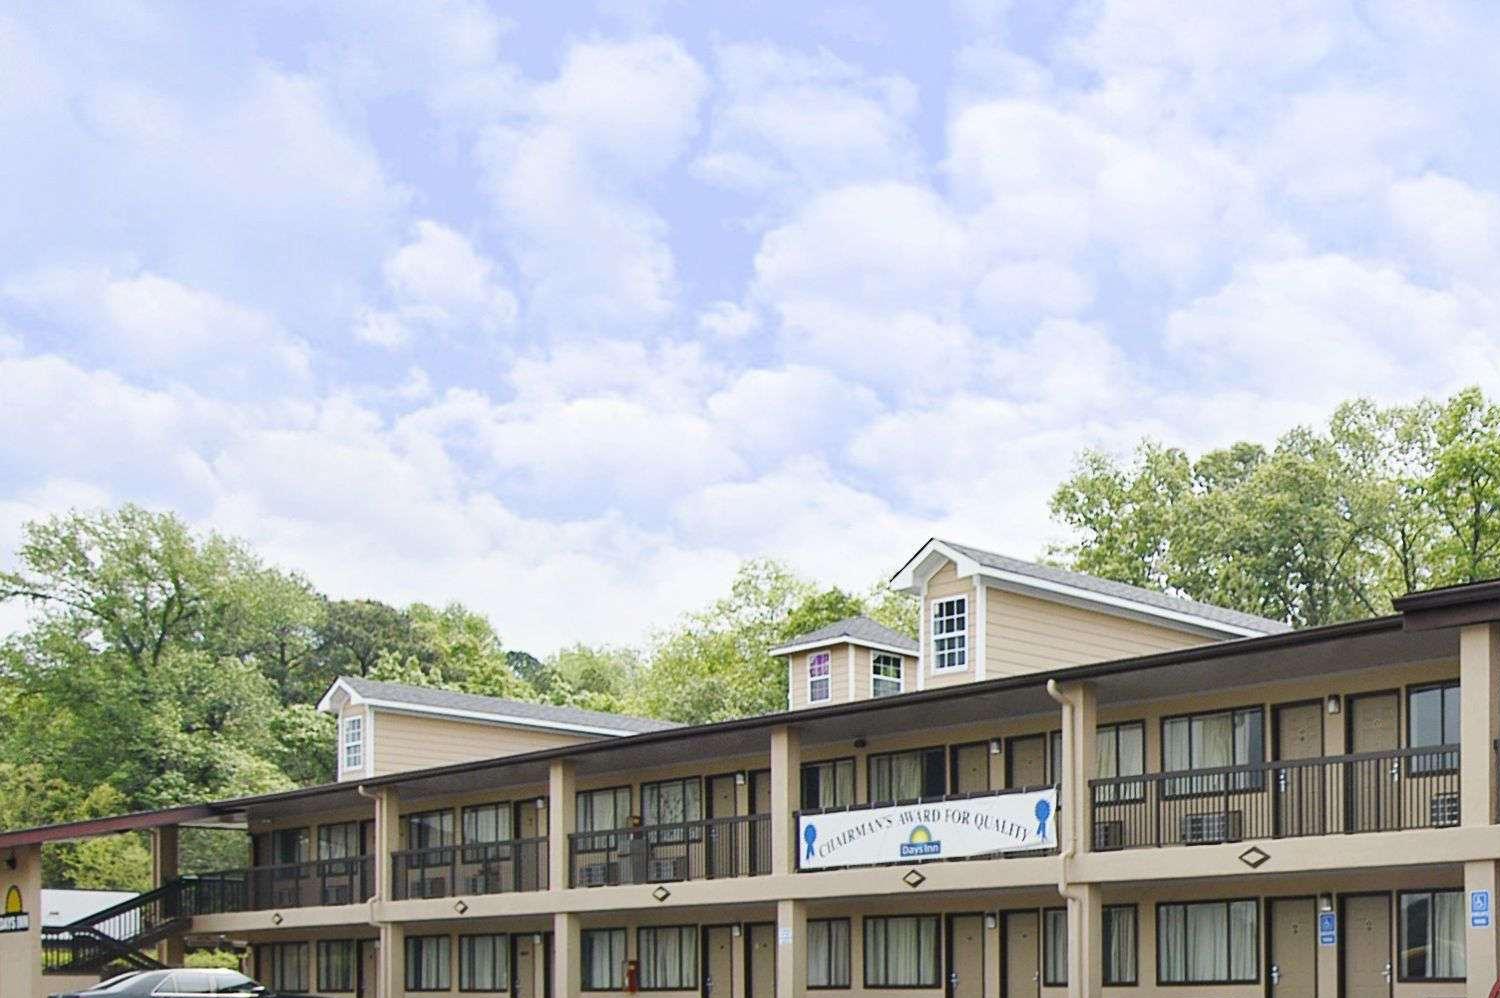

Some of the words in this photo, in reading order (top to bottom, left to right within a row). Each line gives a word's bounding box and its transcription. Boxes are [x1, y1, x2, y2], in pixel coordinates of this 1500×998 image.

[818, 815, 893, 858] CHAIRMAN'S
[899, 808, 940, 825] AWARD
[945, 807, 970, 824] FOR
[975, 812, 1029, 842] QUALITY
[902, 845, 924, 855] Days
